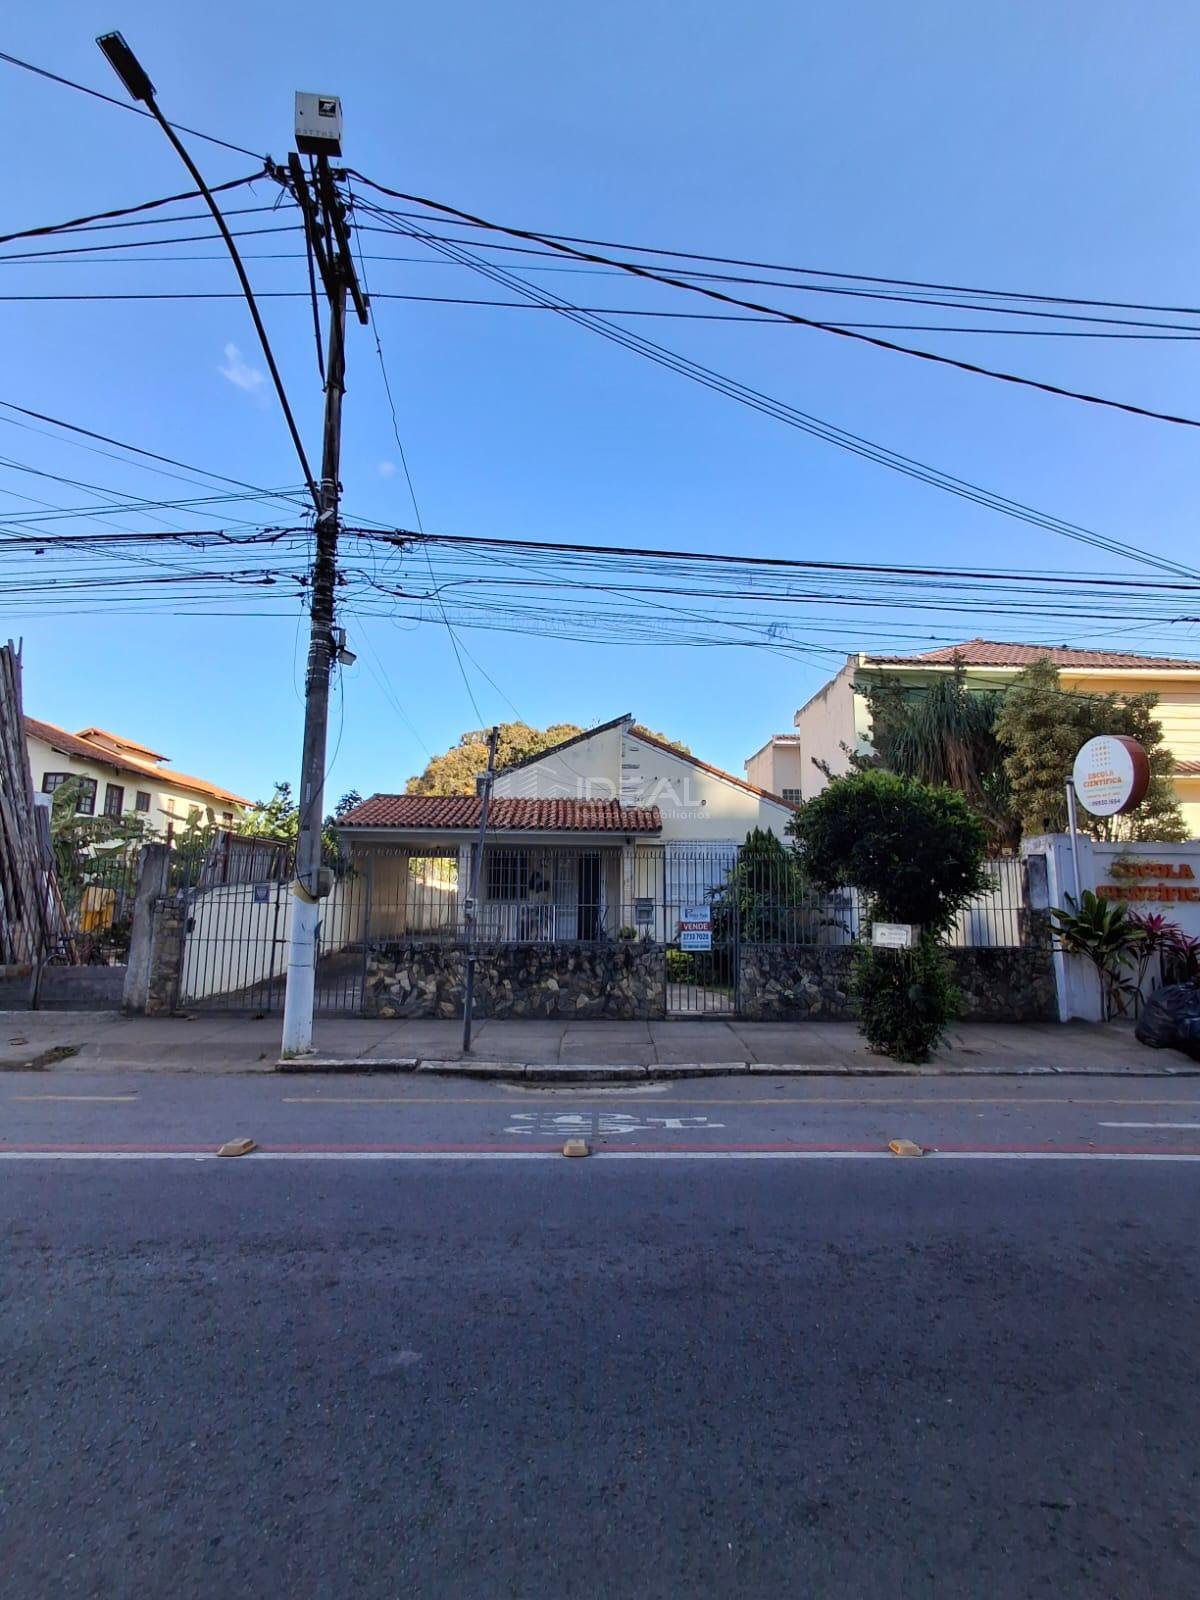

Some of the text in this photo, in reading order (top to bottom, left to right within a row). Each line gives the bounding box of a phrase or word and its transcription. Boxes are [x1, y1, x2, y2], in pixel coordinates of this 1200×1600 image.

[1088, 770, 1114, 779] ESCOLA
[1096, 883, 1200, 902] CIENTÍFIC
[683, 922, 709, 931] VENDE
